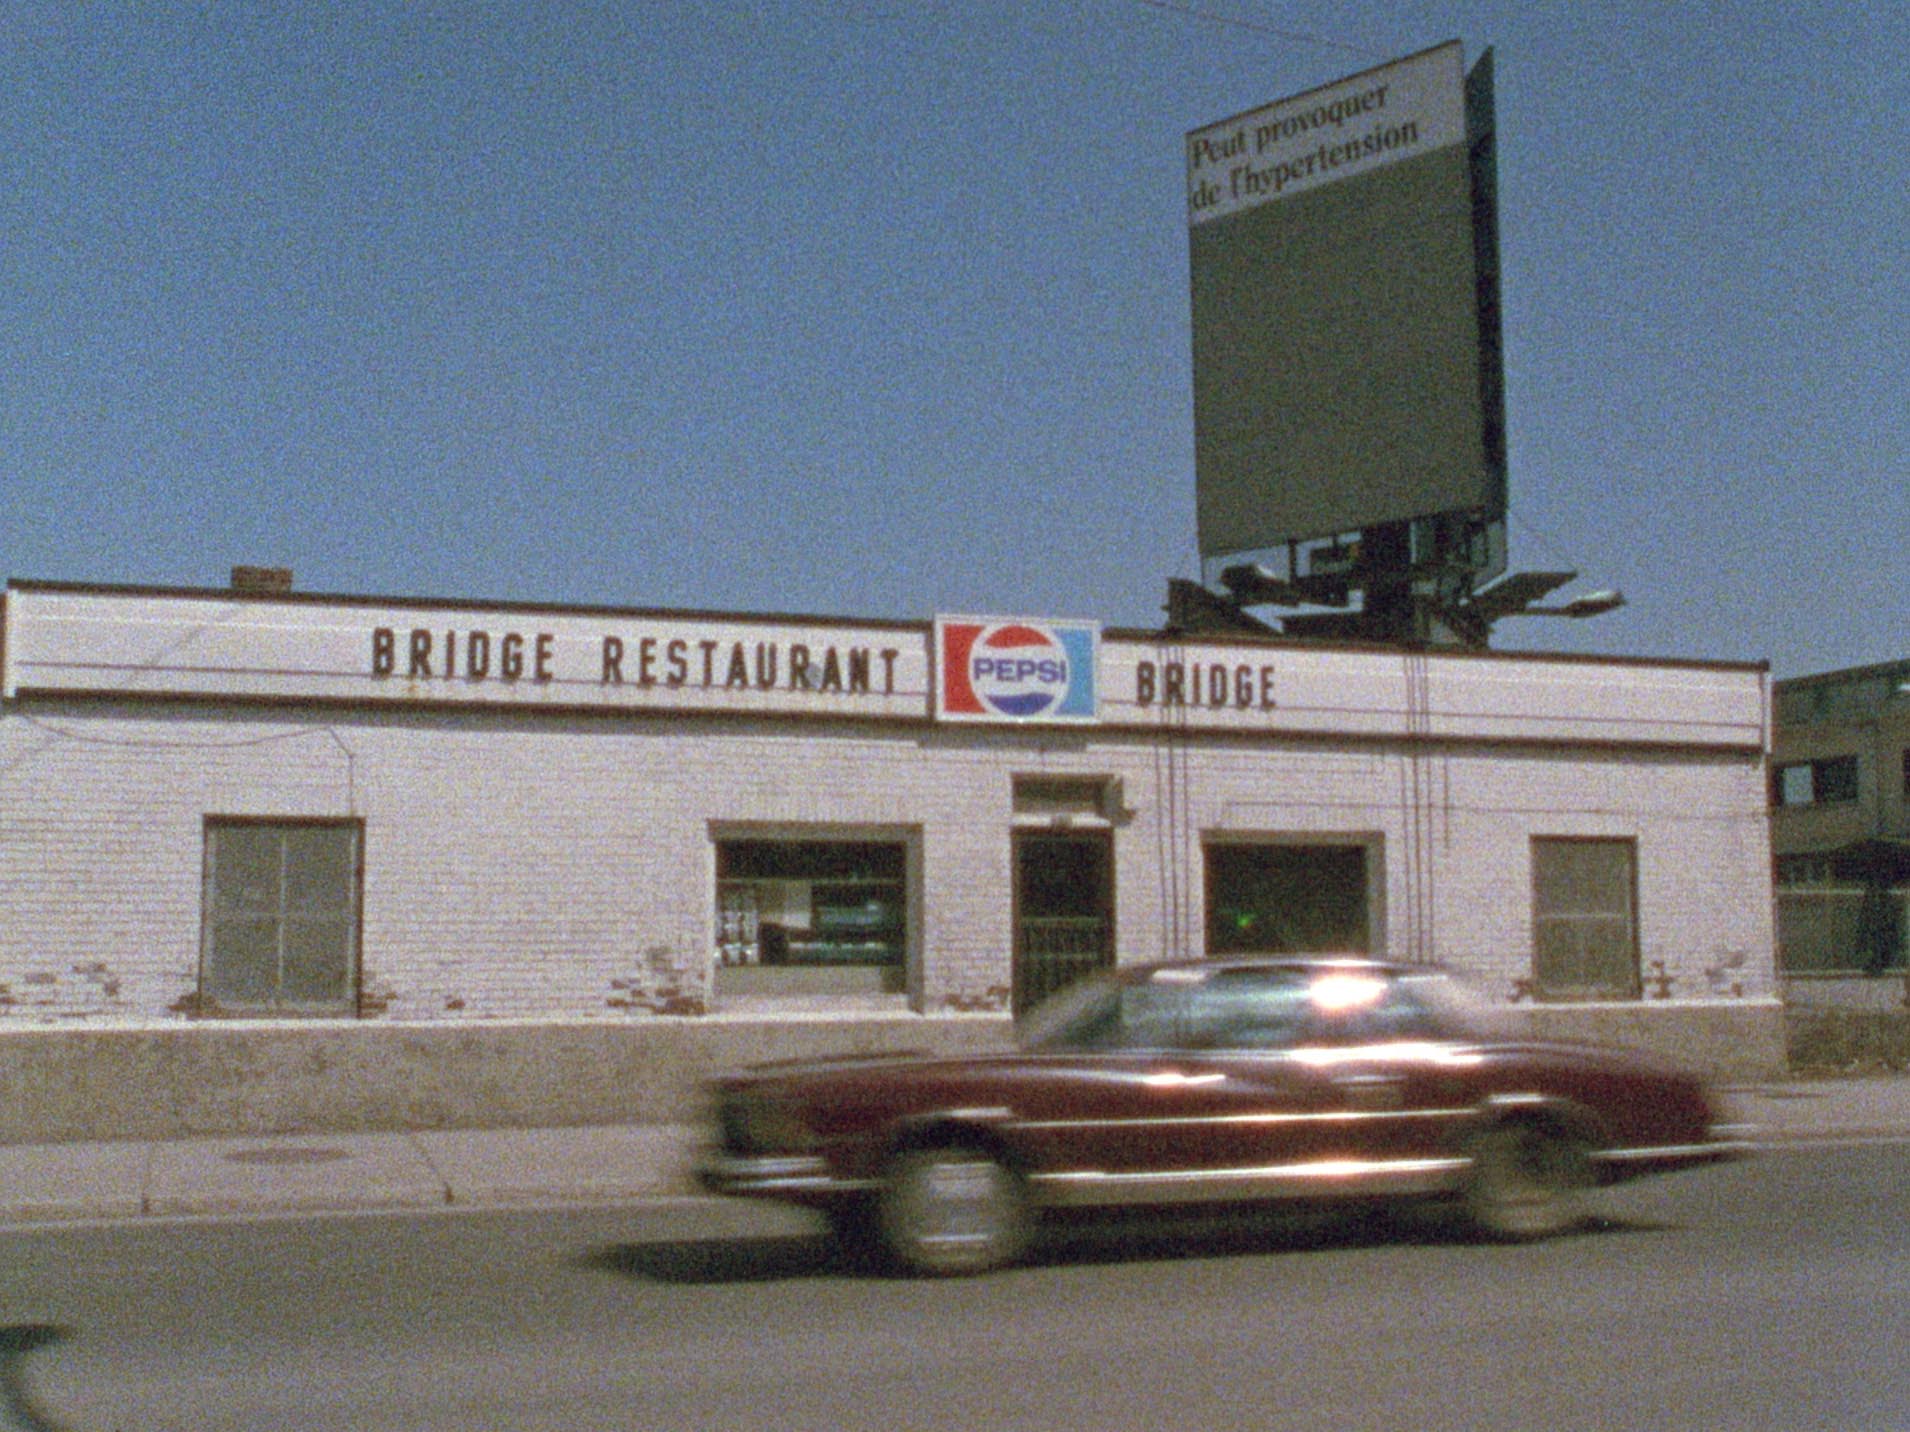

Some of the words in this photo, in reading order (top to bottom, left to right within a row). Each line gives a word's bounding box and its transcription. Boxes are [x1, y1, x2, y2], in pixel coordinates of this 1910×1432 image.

[1192, 131, 1246, 168] Peut
[1257, 86, 1388, 153] provoquer
[1192, 179, 1221, 210] de
[1229, 120, 1418, 198] l'hypertension
[372, 627, 554, 684] BRIDGE
[601, 635, 899, 694] RESTAURANT
[973, 657, 1067, 685] PEPSI
[1136, 661, 1276, 710] BRIDGE
